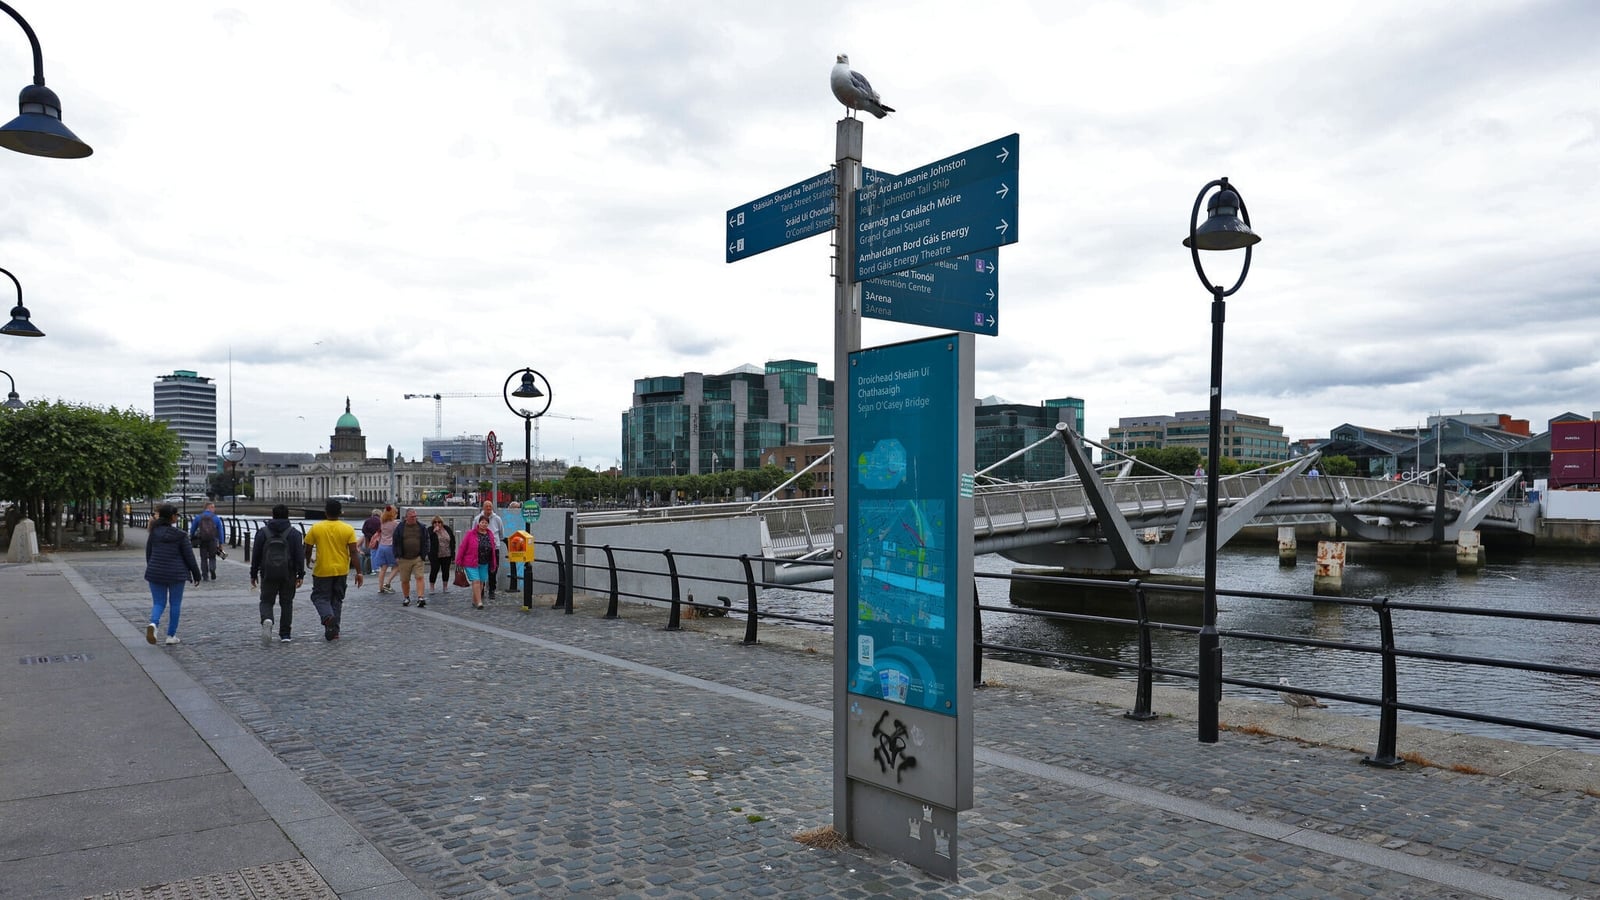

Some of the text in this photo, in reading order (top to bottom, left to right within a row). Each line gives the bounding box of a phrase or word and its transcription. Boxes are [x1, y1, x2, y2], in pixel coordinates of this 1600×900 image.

[860, 158, 966, 202] Long Ard an Jeanie Johnston
[774, 189, 792, 204] Shráid
[792, 188, 800, 196] na
[781, 188, 835, 213] Tara Street Station
[883, 190, 916, 208] Johnston
[918, 184, 930, 195] Tall
[933, 178, 950, 190] Ship
[785, 214, 800, 227] Sráid
[809, 202, 834, 219] Chonaill
[860, 193, 961, 232] Cearnóg na Canálach Móire
[785, 217, 834, 238] O'Connell Street
[860, 218, 930, 245] Grand Canal Square
[859, 226, 970, 262] Amharclann Bord Gáis Energy
[859, 264, 875, 276] Bord
[877, 259, 892, 271] Gáis
[894, 254, 919, 267] Energy
[921, 245, 951, 260] Theatre
[865, 291, 892, 304] 3Arena
[908, 282, 932, 293] Centre
[865, 304, 892, 316] 3Arena
[858, 371, 893, 385] Droichead
[894, 367, 919, 381] Sheáin
[858, 384, 900, 398] Chathasaigh
[876, 399, 903, 410] O'Casey
[905, 396, 930, 408] Bridge
[190, 464, 207, 475] NOW
